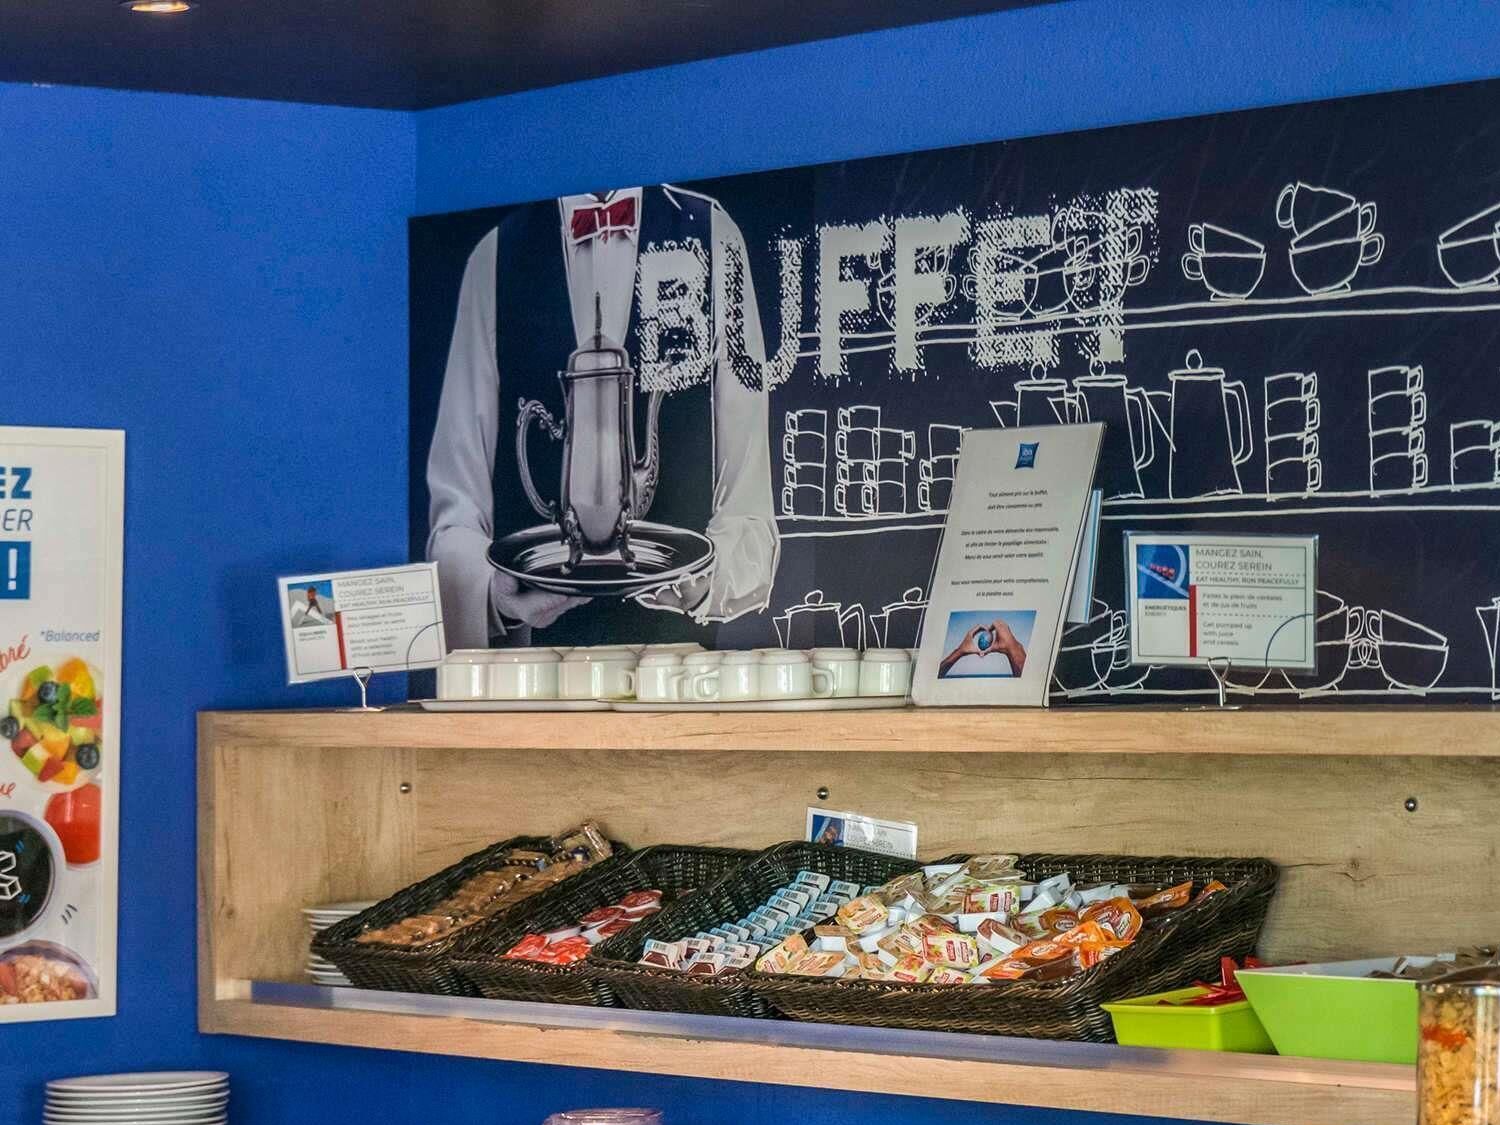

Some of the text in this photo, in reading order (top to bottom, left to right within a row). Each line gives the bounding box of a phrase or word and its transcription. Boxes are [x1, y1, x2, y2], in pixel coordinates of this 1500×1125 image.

[634, 188, 1160, 399] BUFFET
[1195, 549, 1237, 558] MANGEZ
[1195, 561, 1272, 571] COUREZ SEREIN
